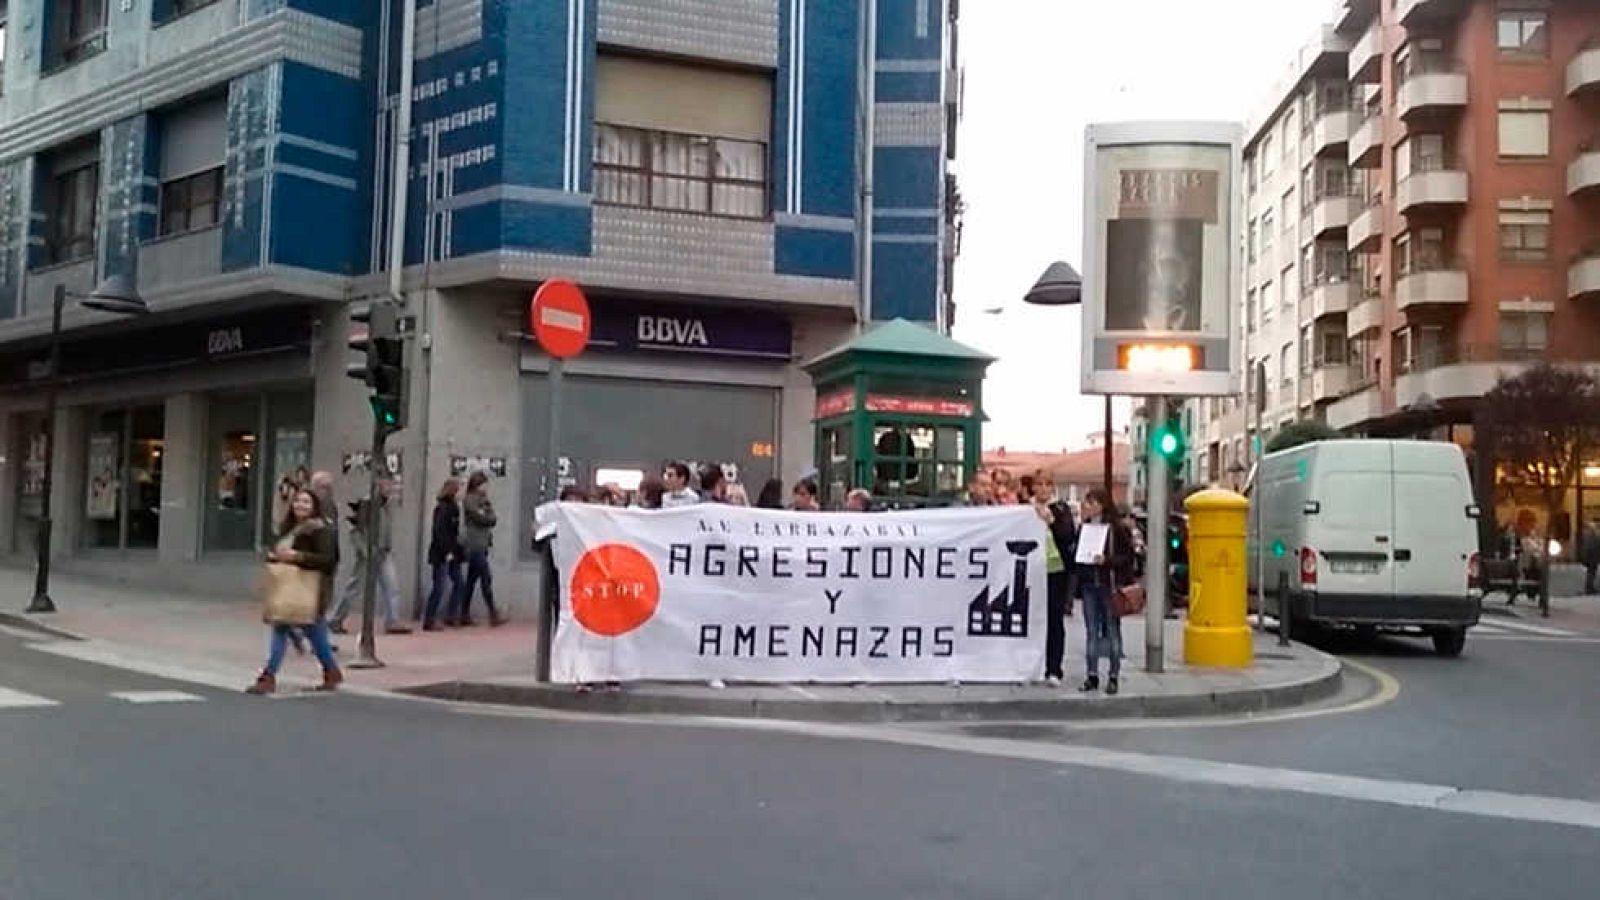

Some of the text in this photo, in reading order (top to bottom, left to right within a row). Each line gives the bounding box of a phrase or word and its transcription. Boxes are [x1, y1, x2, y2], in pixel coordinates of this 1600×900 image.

[208, 328, 244, 354] BBVA
[638, 315, 708, 345] BBVA
[669, 543, 990, 579] AGRESIONES
[583, 581, 646, 600] STOP
[824, 589, 842, 614] Y
[699, 625, 955, 658] AMENAZAS
